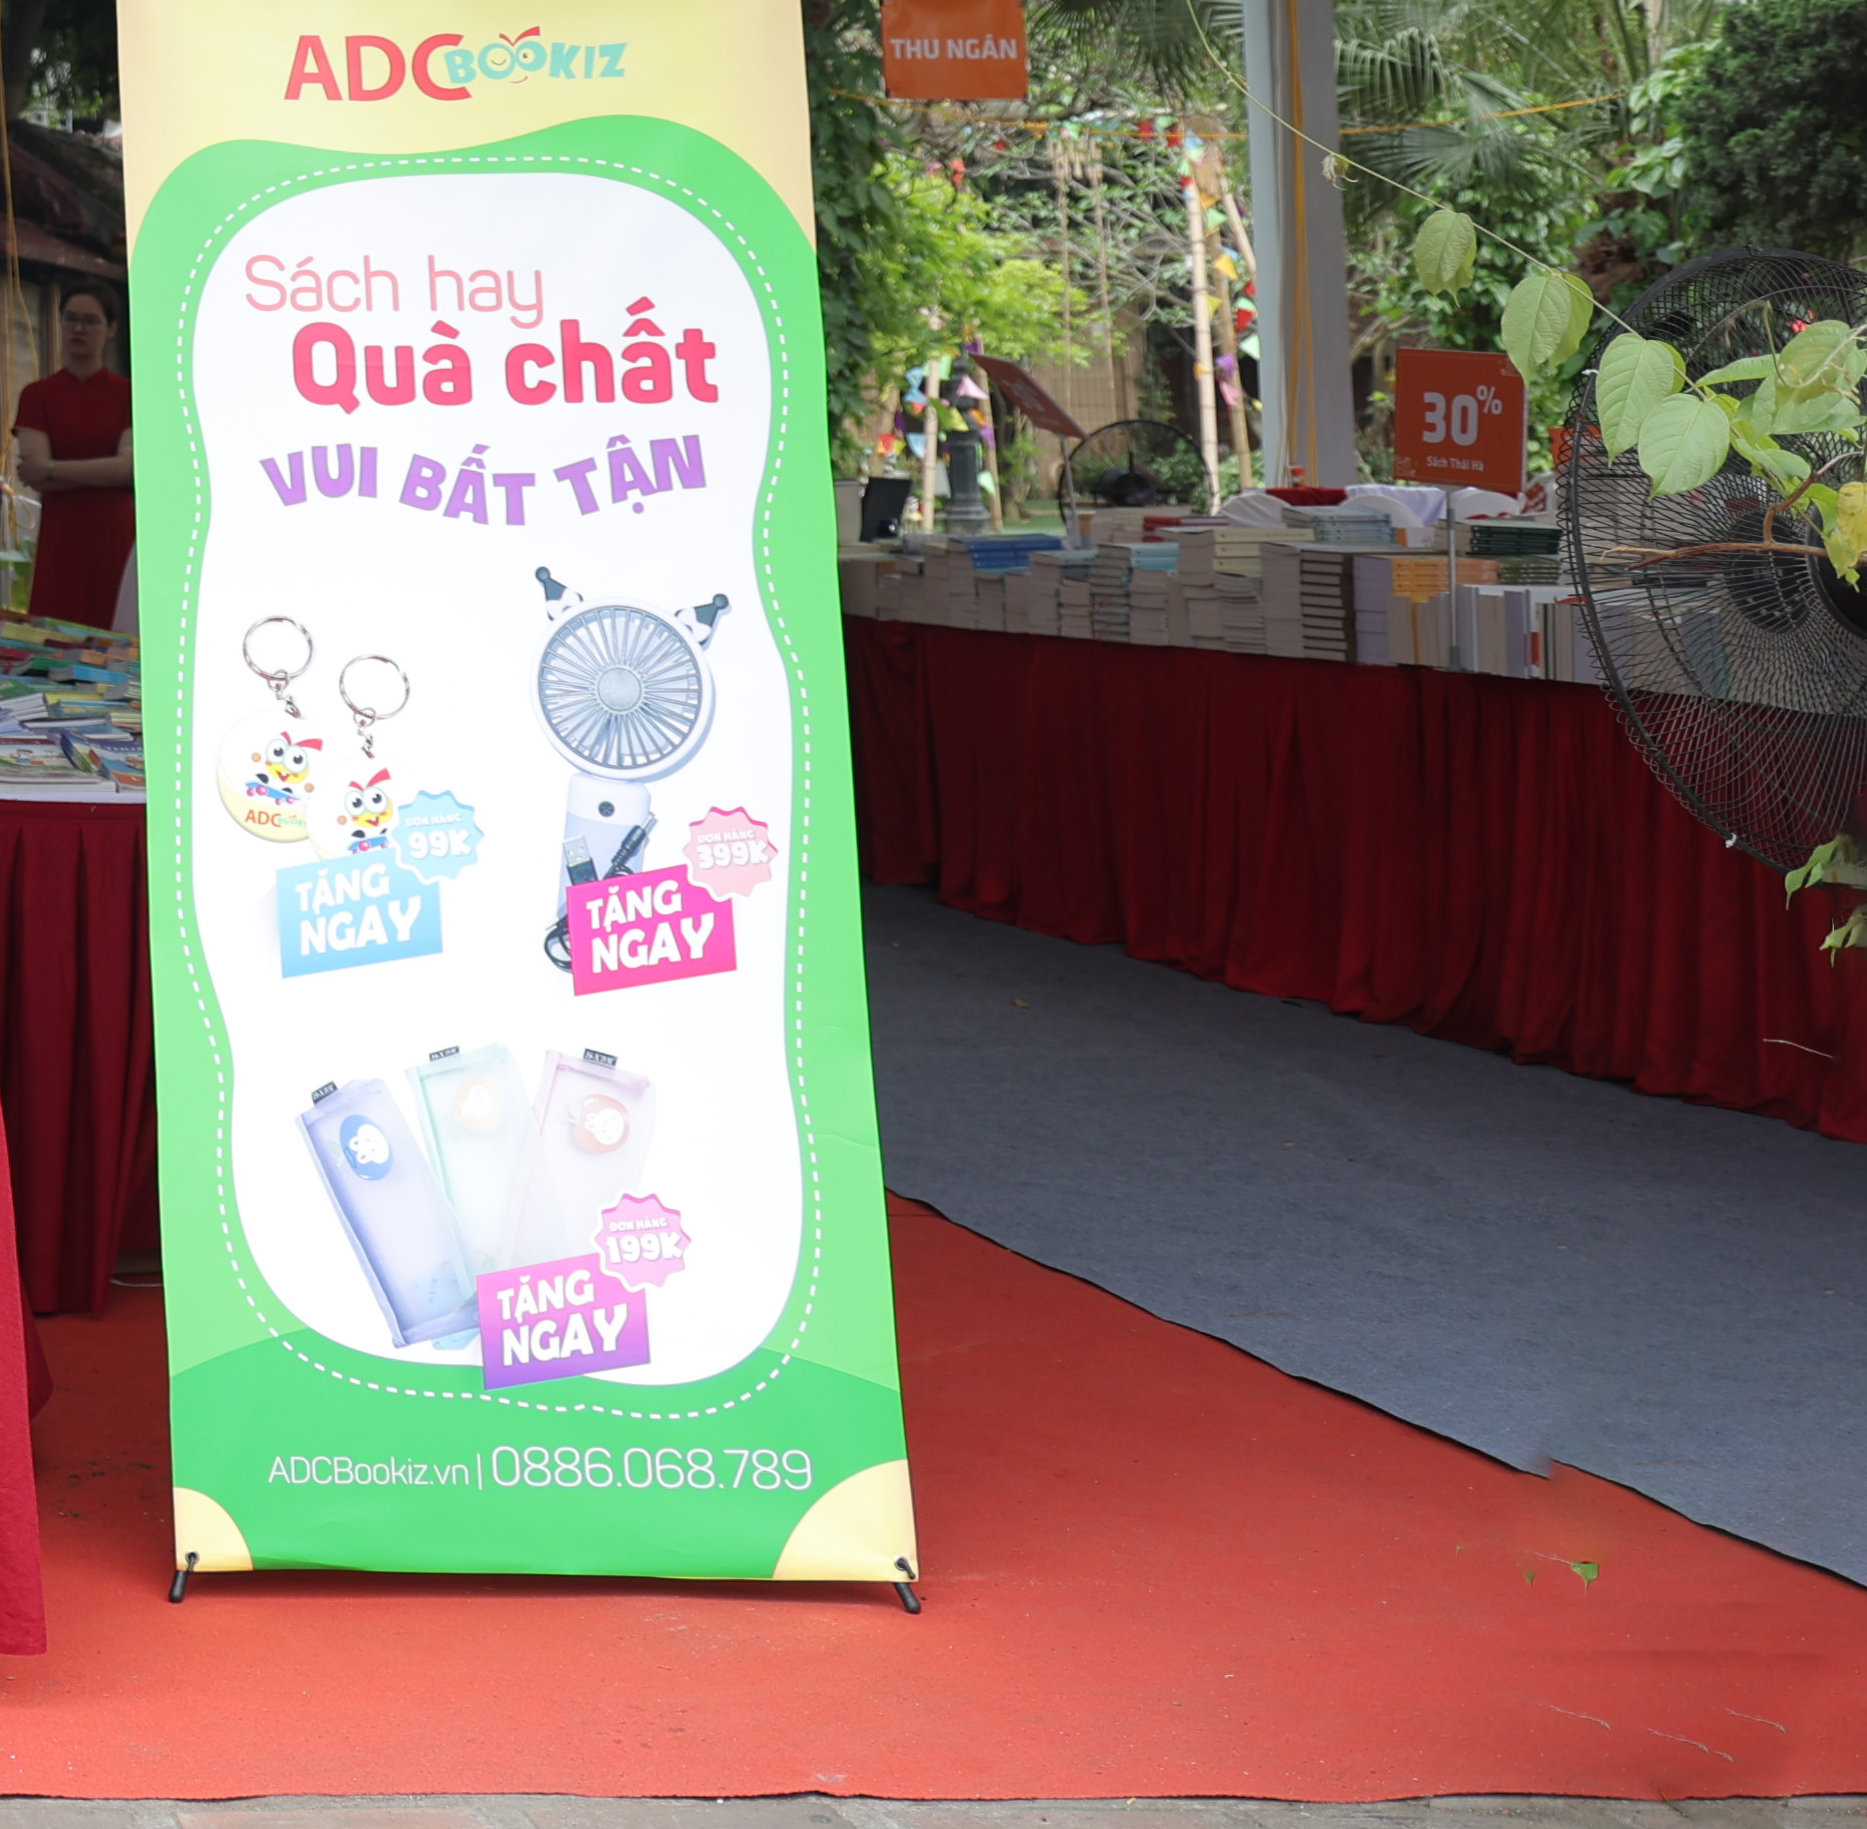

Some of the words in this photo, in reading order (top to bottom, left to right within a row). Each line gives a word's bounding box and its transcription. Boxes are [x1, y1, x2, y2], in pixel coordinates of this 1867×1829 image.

[285, 34, 472, 102] ADC
[890, 35, 941, 61] THU
[947, 31, 1018, 61] NGÂN
[244, 254, 398, 313] Sách
[428, 255, 545, 329] hay
[292, 321, 473, 414] Quà
[504, 296, 719, 405] chất
[1422, 385, 1503, 446] 30%
[260, 443, 377, 506] VUI
[399, 442, 536, 526] BẤT
[554, 434, 707, 515] TẬN
[245, 809, 282, 828] ADC
[408, 827, 472, 860] 99K
[697, 831, 722, 844] ĐƠN
[723, 828, 755, 842] HÀNG
[696, 838, 771, 870] 399K
[295, 861, 390, 917] TẶNG
[586, 884, 683, 934] TẶNG
[298, 895, 423, 957] NGAY
[590, 912, 716, 974] NGAY
[606, 1231, 684, 1265] 199K
[609, 1220, 634, 1233] ĐƠN
[635, 1216, 668, 1231] HÀNG
[497, 1269, 594, 1322] TẶNG
[502, 1303, 628, 1367] NGAY
[268, 1454, 469, 1487] ADCBookiz.vn
[491, 1445, 813, 1491] 0886.068.789
